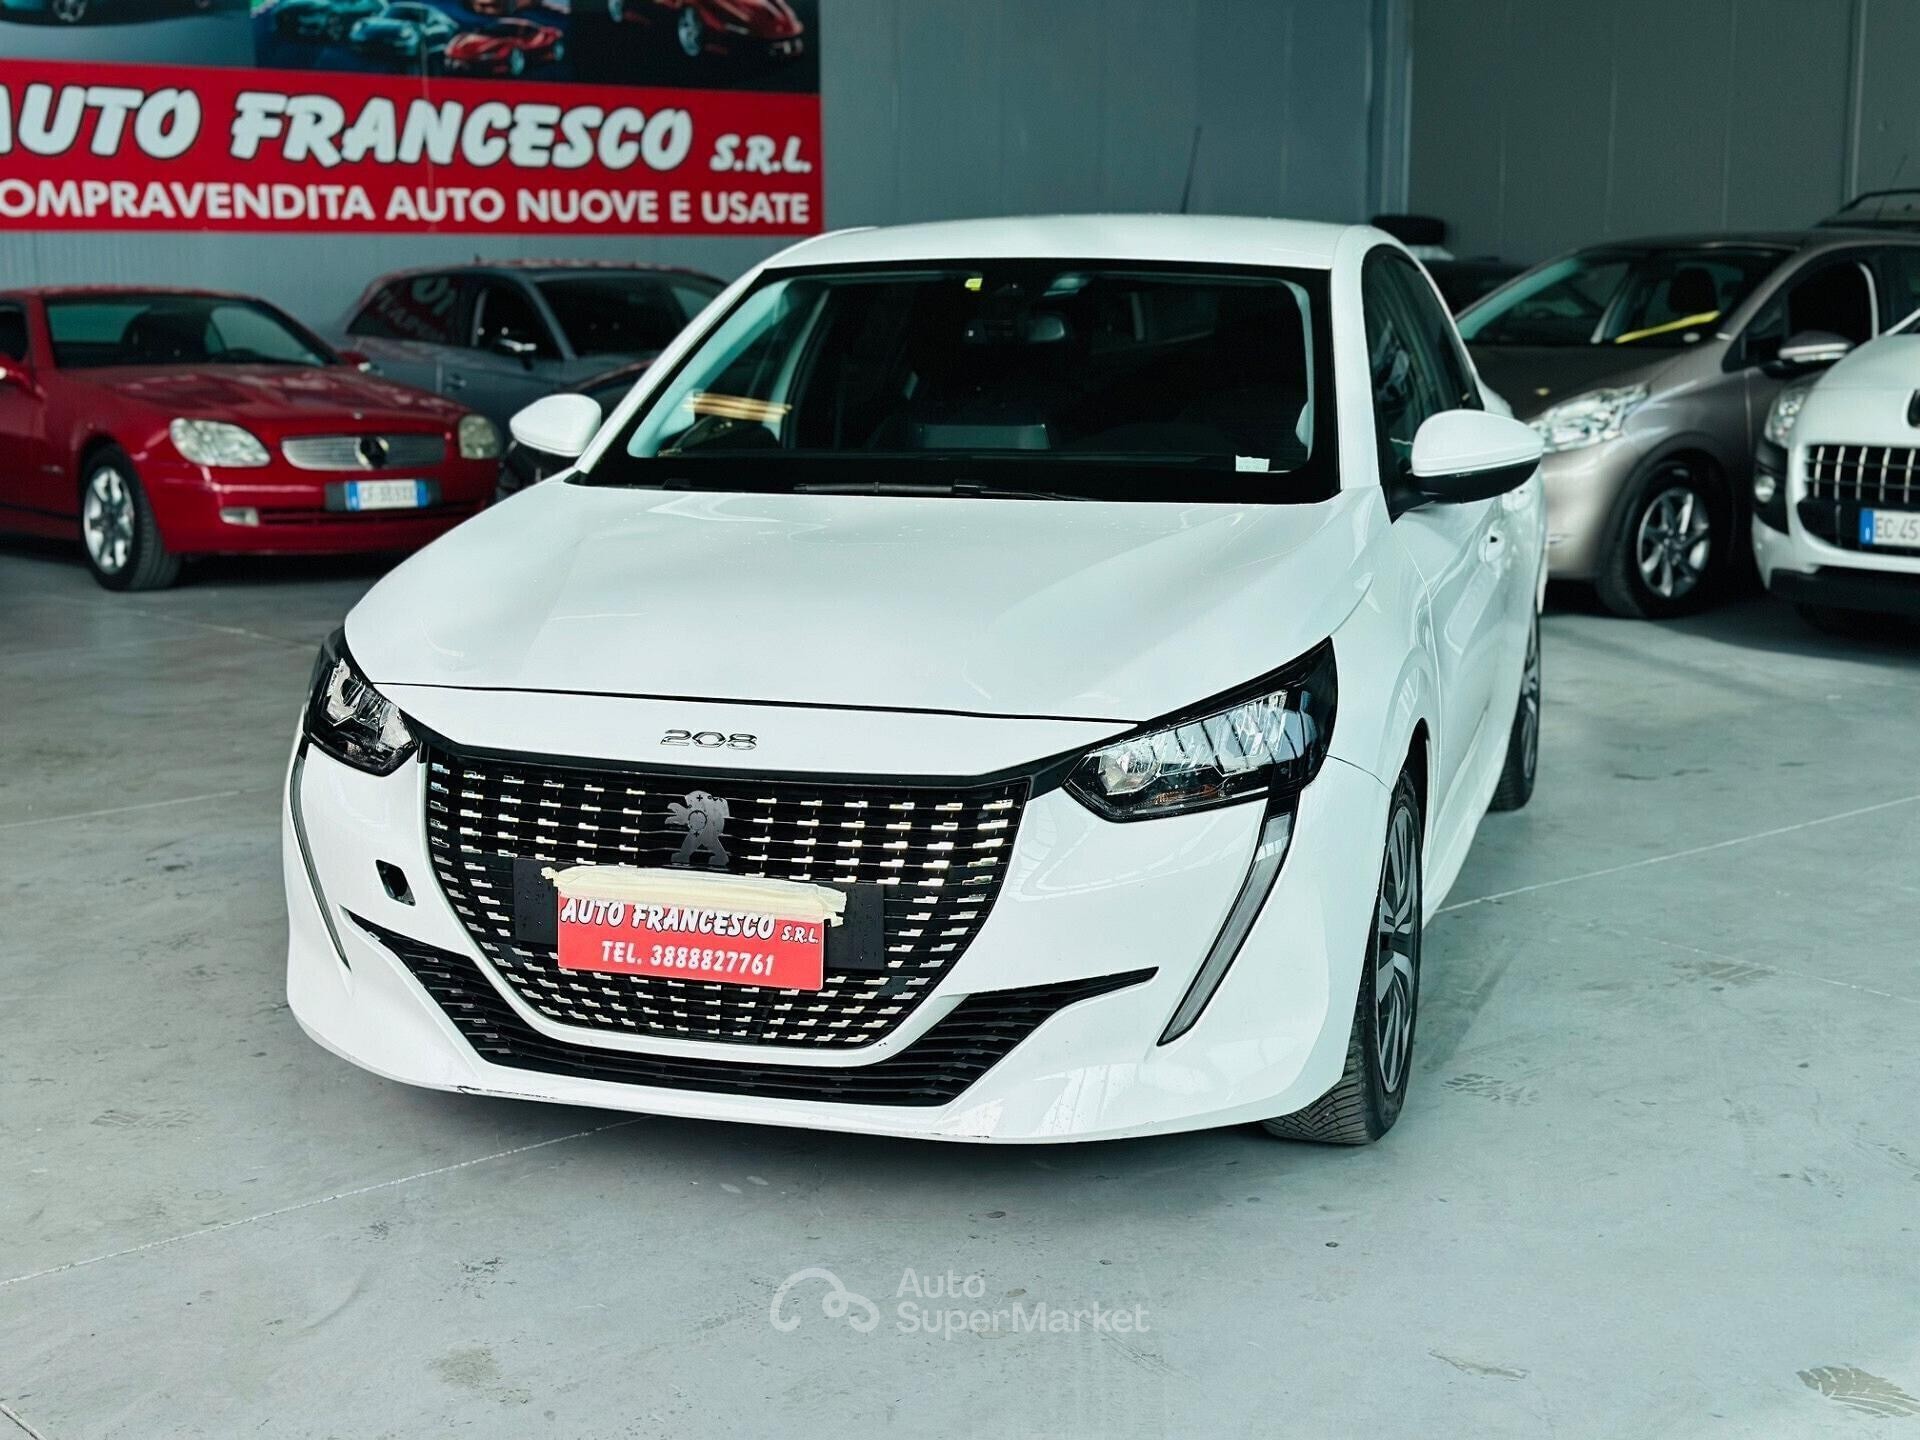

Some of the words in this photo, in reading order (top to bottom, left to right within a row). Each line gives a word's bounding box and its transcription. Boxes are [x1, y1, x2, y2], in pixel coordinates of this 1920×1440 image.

[229, 88, 693, 170] FRANCESCO
[710, 133, 812, 174] S.R.L.
[384, 186, 505, 223] AUTO
[517, 188, 658, 224] NUOVE
[670, 191, 691, 223] E
[702, 192, 809, 224] USATE
[660, 729, 758, 750] 208
[560, 898, 625, 927] AUTO
[631, 902, 776, 940] FRANCESCO
[781, 925, 819, 943] S.R.L.
[601, 940, 642, 965] TEL.
[650, 944, 775, 976] 3888827761
